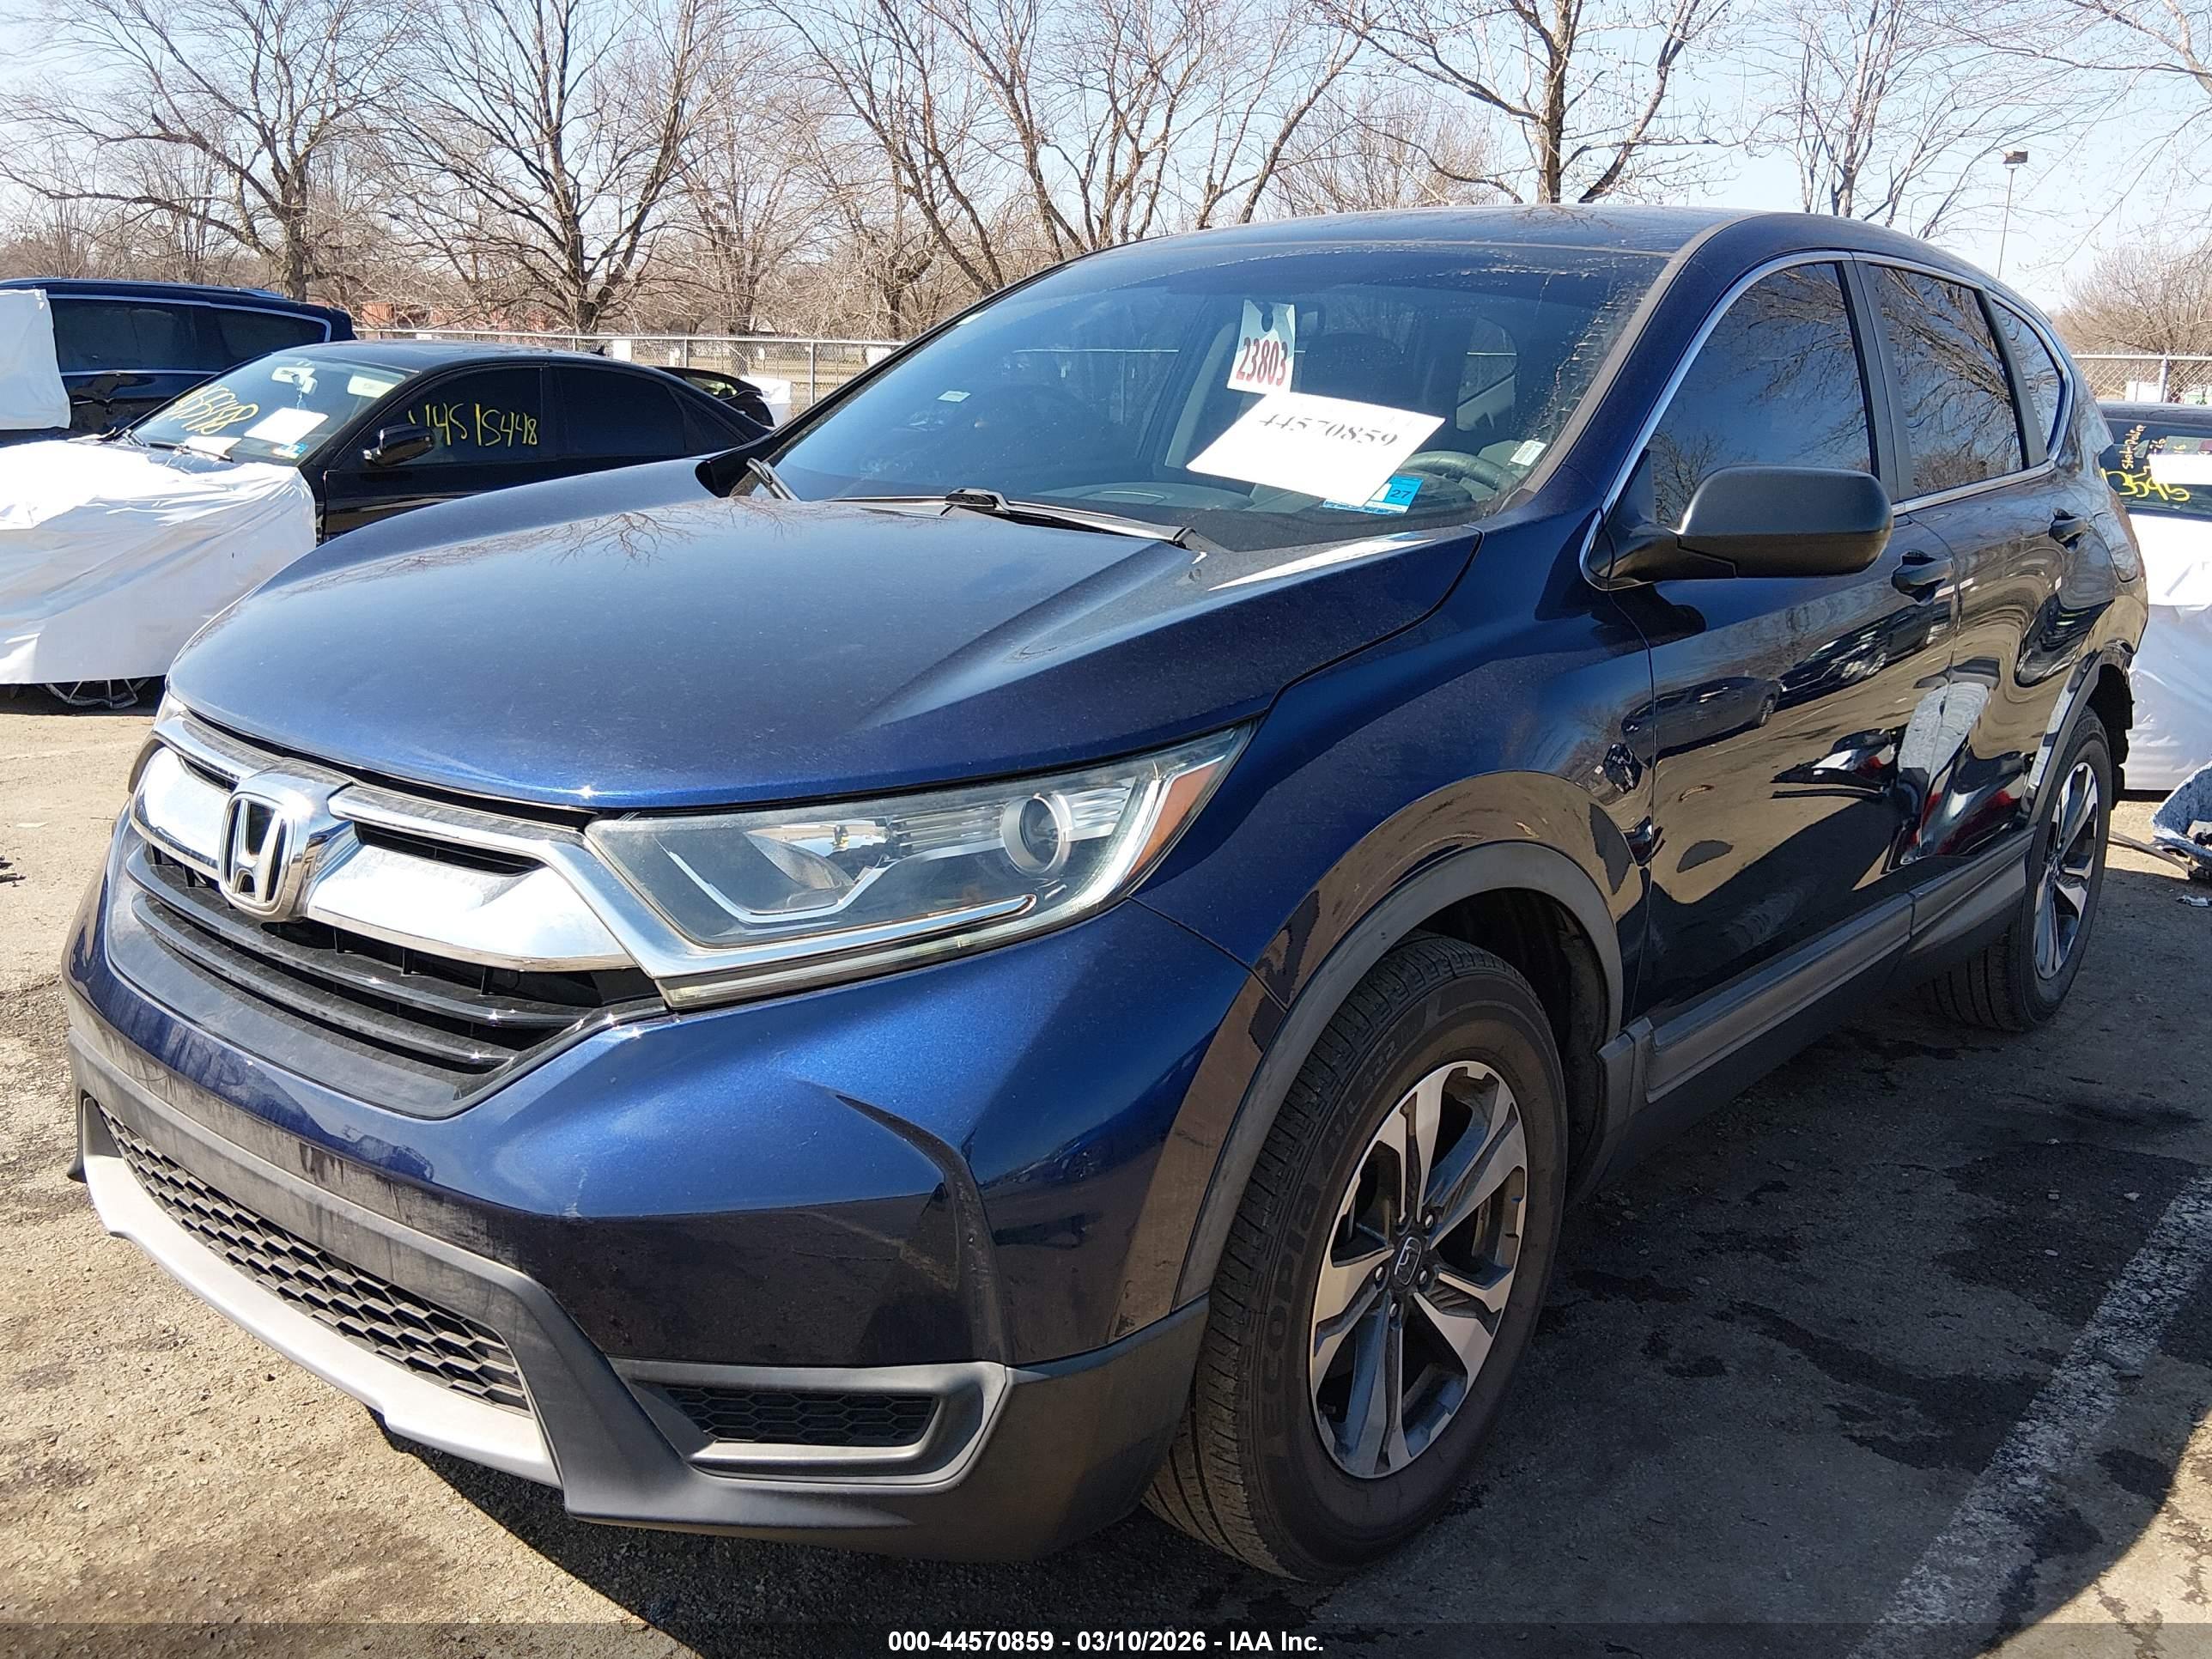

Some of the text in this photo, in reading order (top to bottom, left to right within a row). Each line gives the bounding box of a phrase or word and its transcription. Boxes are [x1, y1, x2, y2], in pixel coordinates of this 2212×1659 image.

[1236, 337, 1288, 386] 23803
[1259, 413, 1398, 447] 44570859
[1390, 489, 1413, 499] 27
